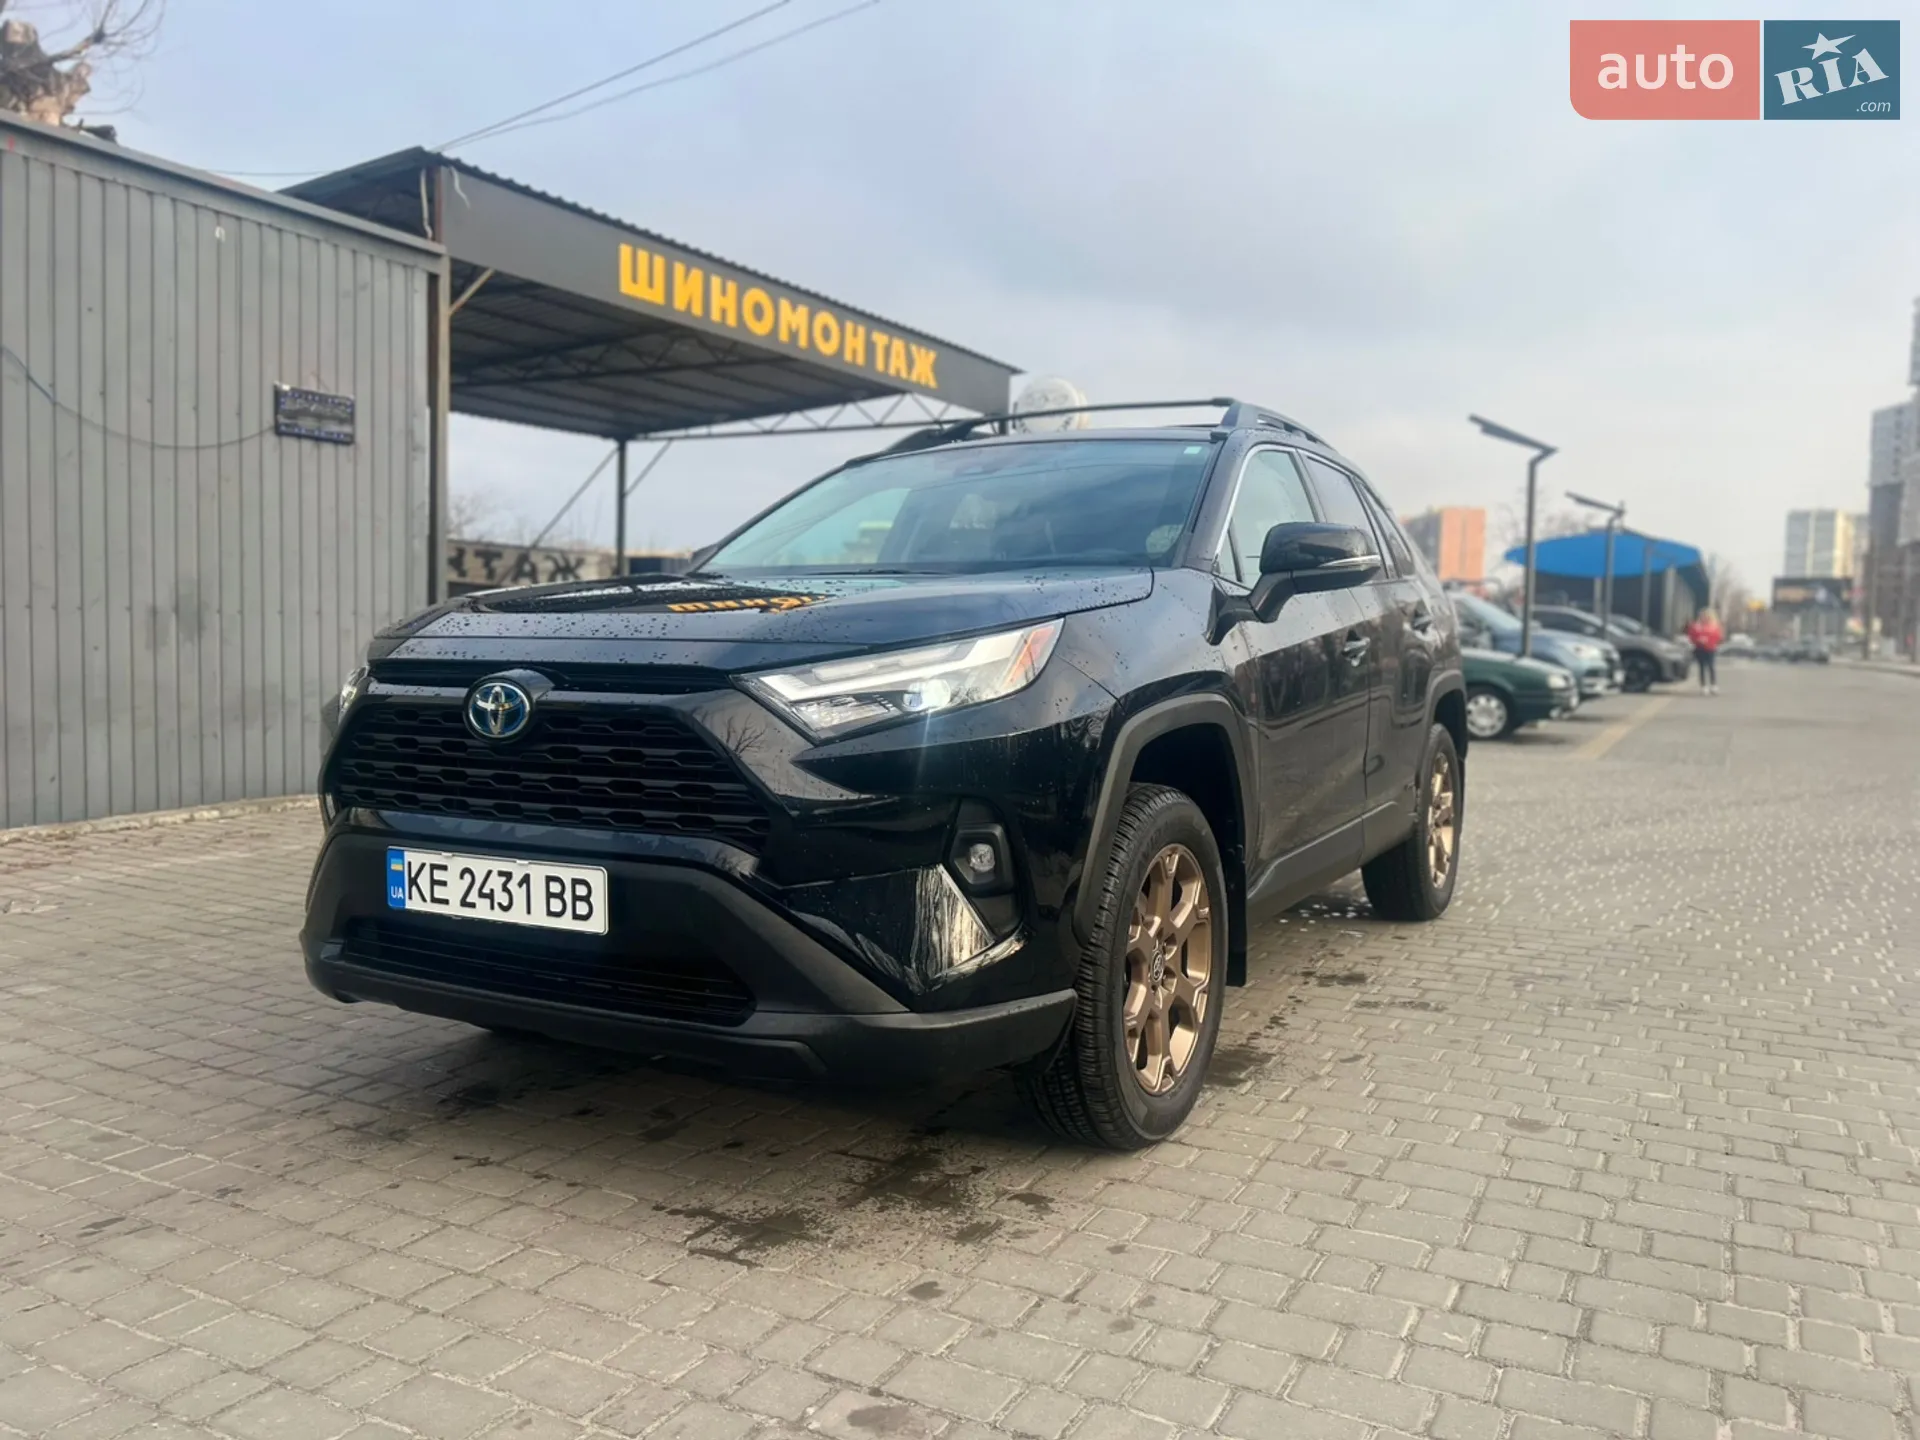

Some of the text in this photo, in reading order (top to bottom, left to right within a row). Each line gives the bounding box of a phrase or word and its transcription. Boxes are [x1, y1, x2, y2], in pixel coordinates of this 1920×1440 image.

[619, 243, 938, 388] ШИНОМОНТАЖ
[391, 886, 404, 899] UA
[407, 861, 594, 921] KE 2431 BB
